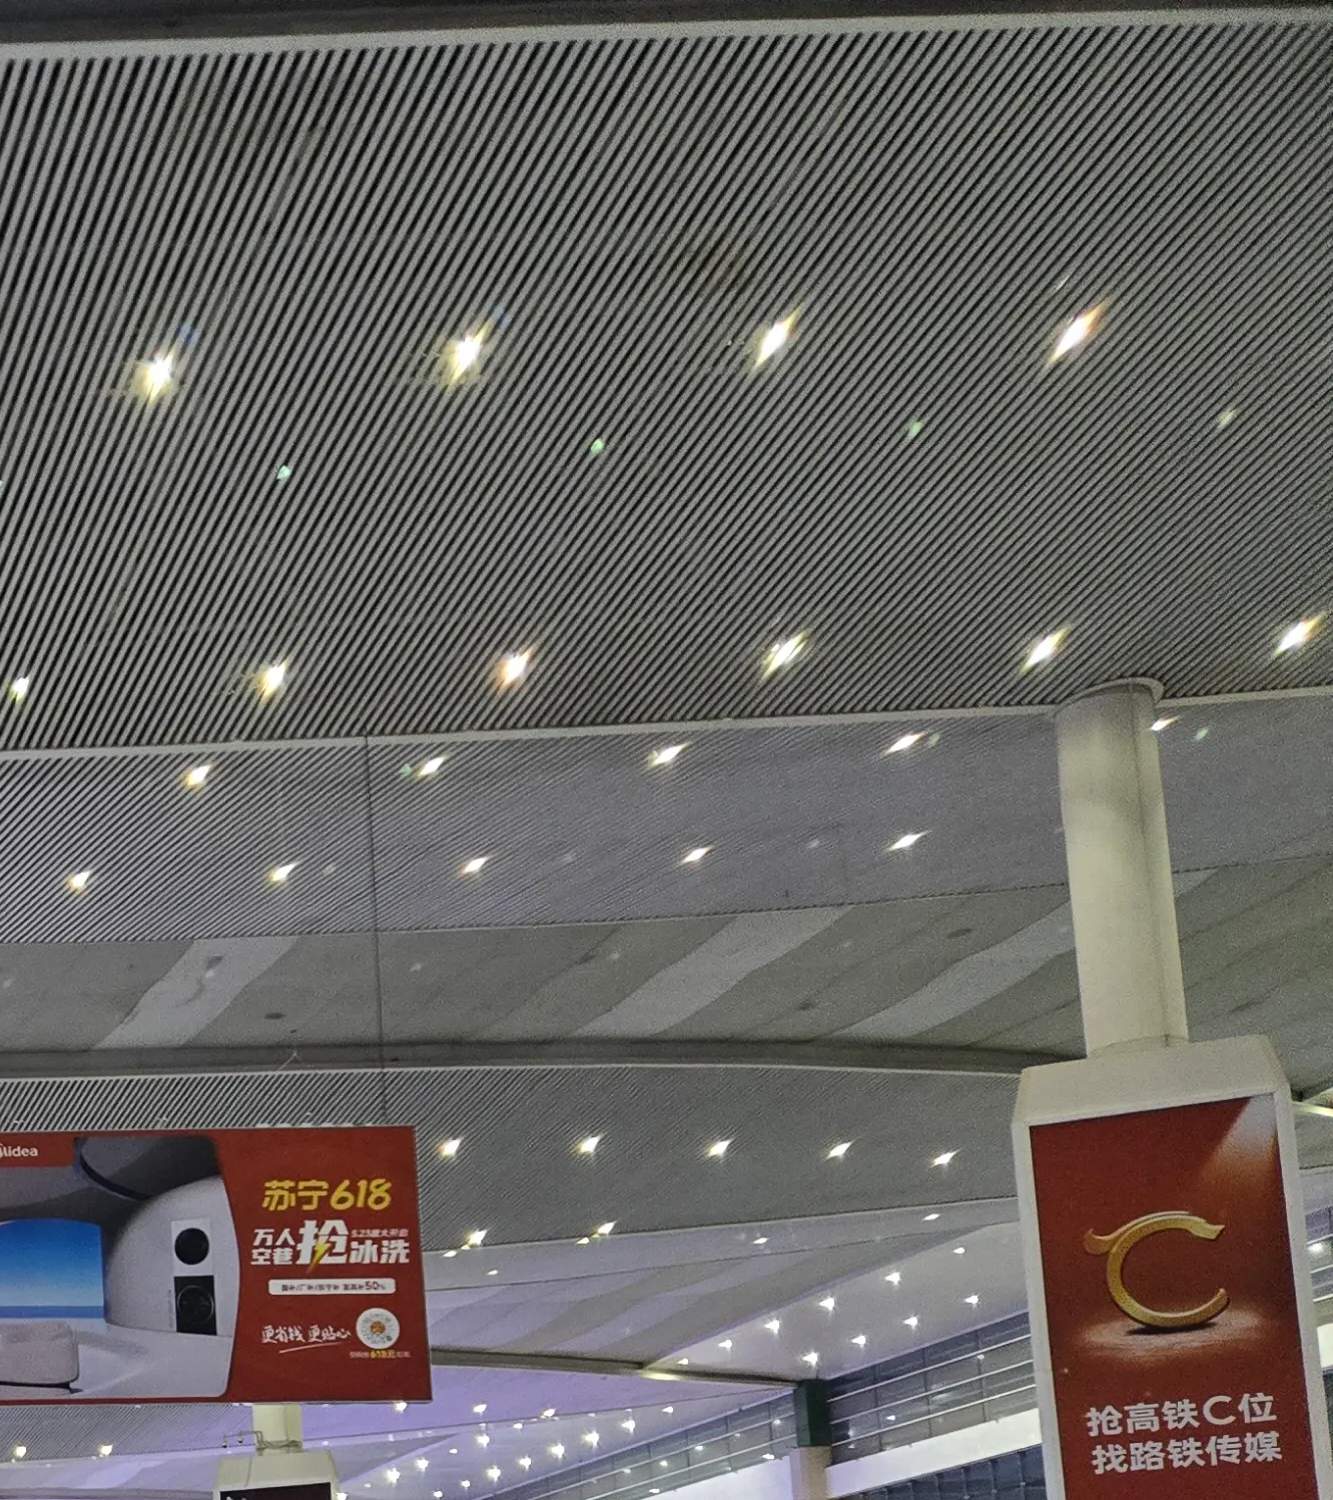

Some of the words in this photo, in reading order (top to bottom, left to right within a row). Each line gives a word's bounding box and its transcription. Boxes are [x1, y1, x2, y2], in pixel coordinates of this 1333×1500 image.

[261, 1178, 392, 1211] 苏宁618
[253, 1228, 295, 1247] 万人
[349, 1239, 410, 1264] 冰洗
[251, 1248, 294, 1265] 空巷
[1085, 1392, 1277, 1436] 抢高铁C位
[1091, 1431, 1282, 1474] 找路铁传媒
